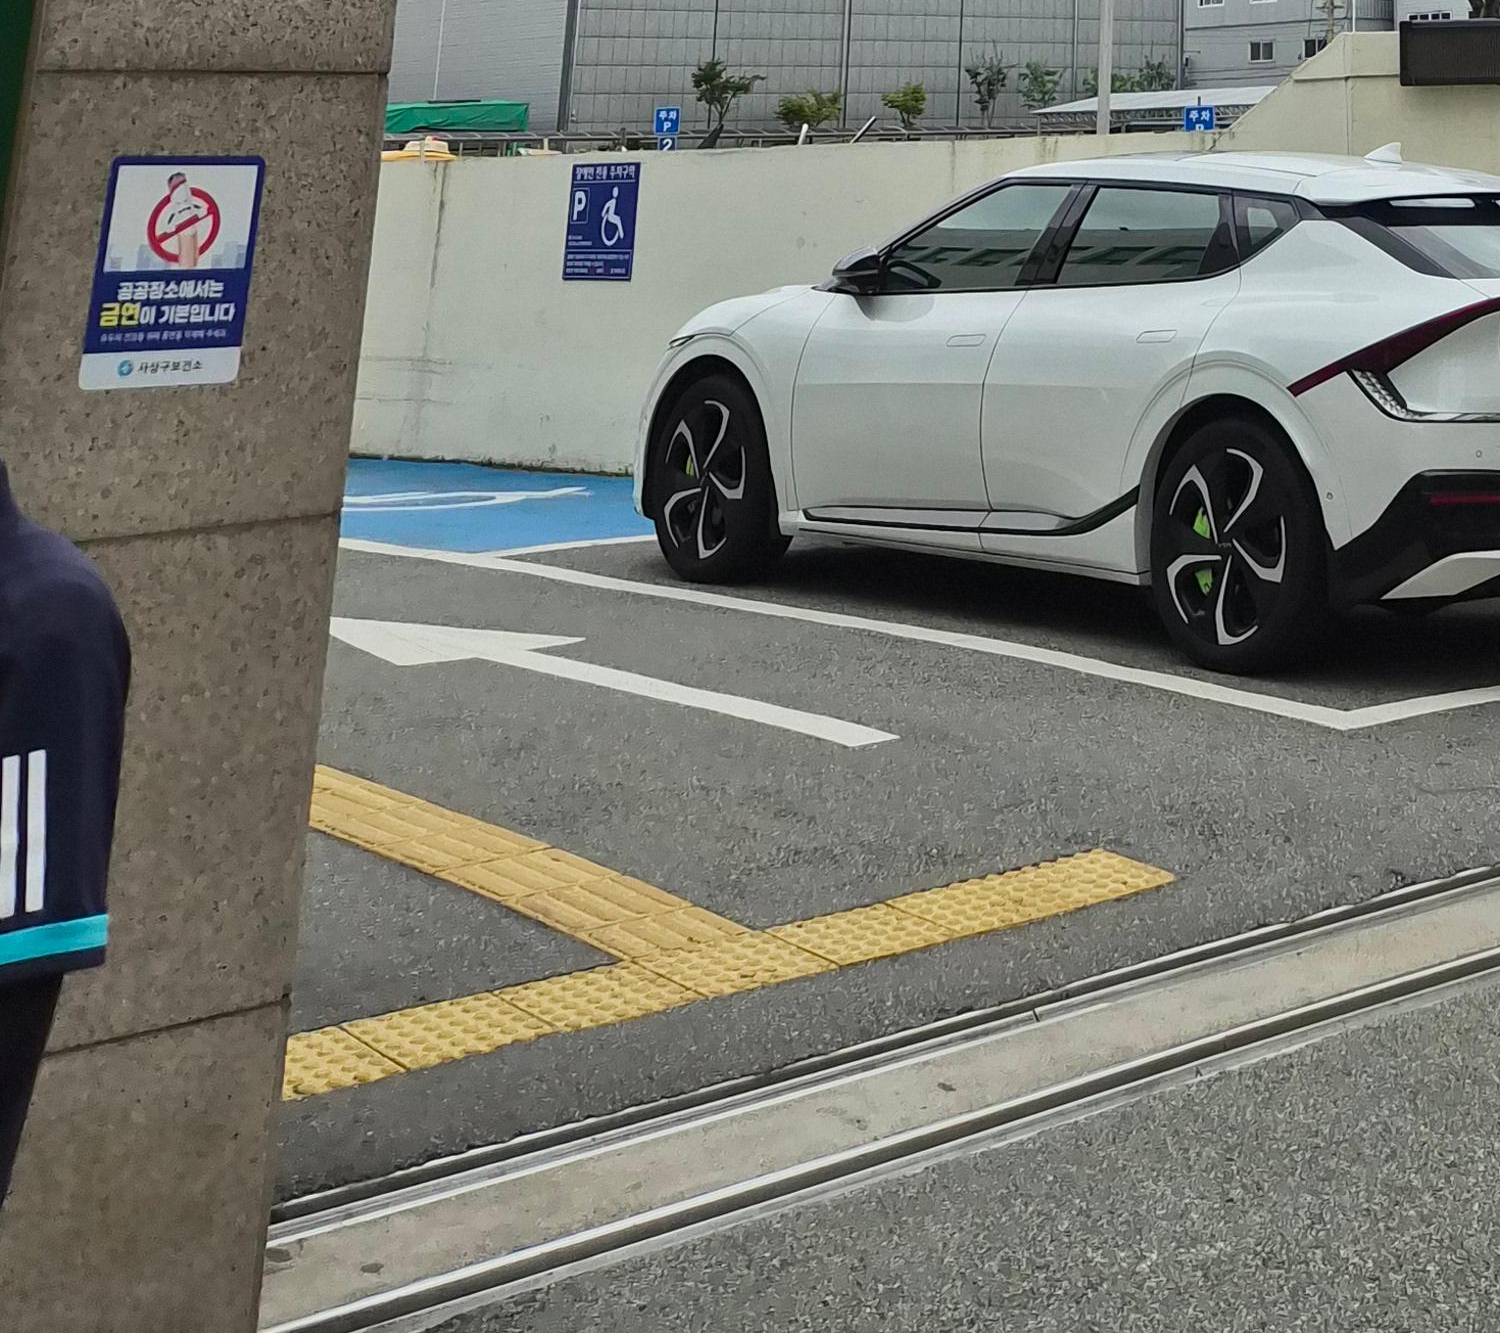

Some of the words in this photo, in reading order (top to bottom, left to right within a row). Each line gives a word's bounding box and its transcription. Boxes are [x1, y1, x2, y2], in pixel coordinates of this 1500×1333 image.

[663, 121, 672, 132] P
[572, 190, 587, 221] P
[117, 279, 224, 301] 공공장소에서는
[100, 301, 157, 326] 금연이
[158, 302, 236, 325] 기본입니다
[138, 360, 203, 374] 사상구보건소
